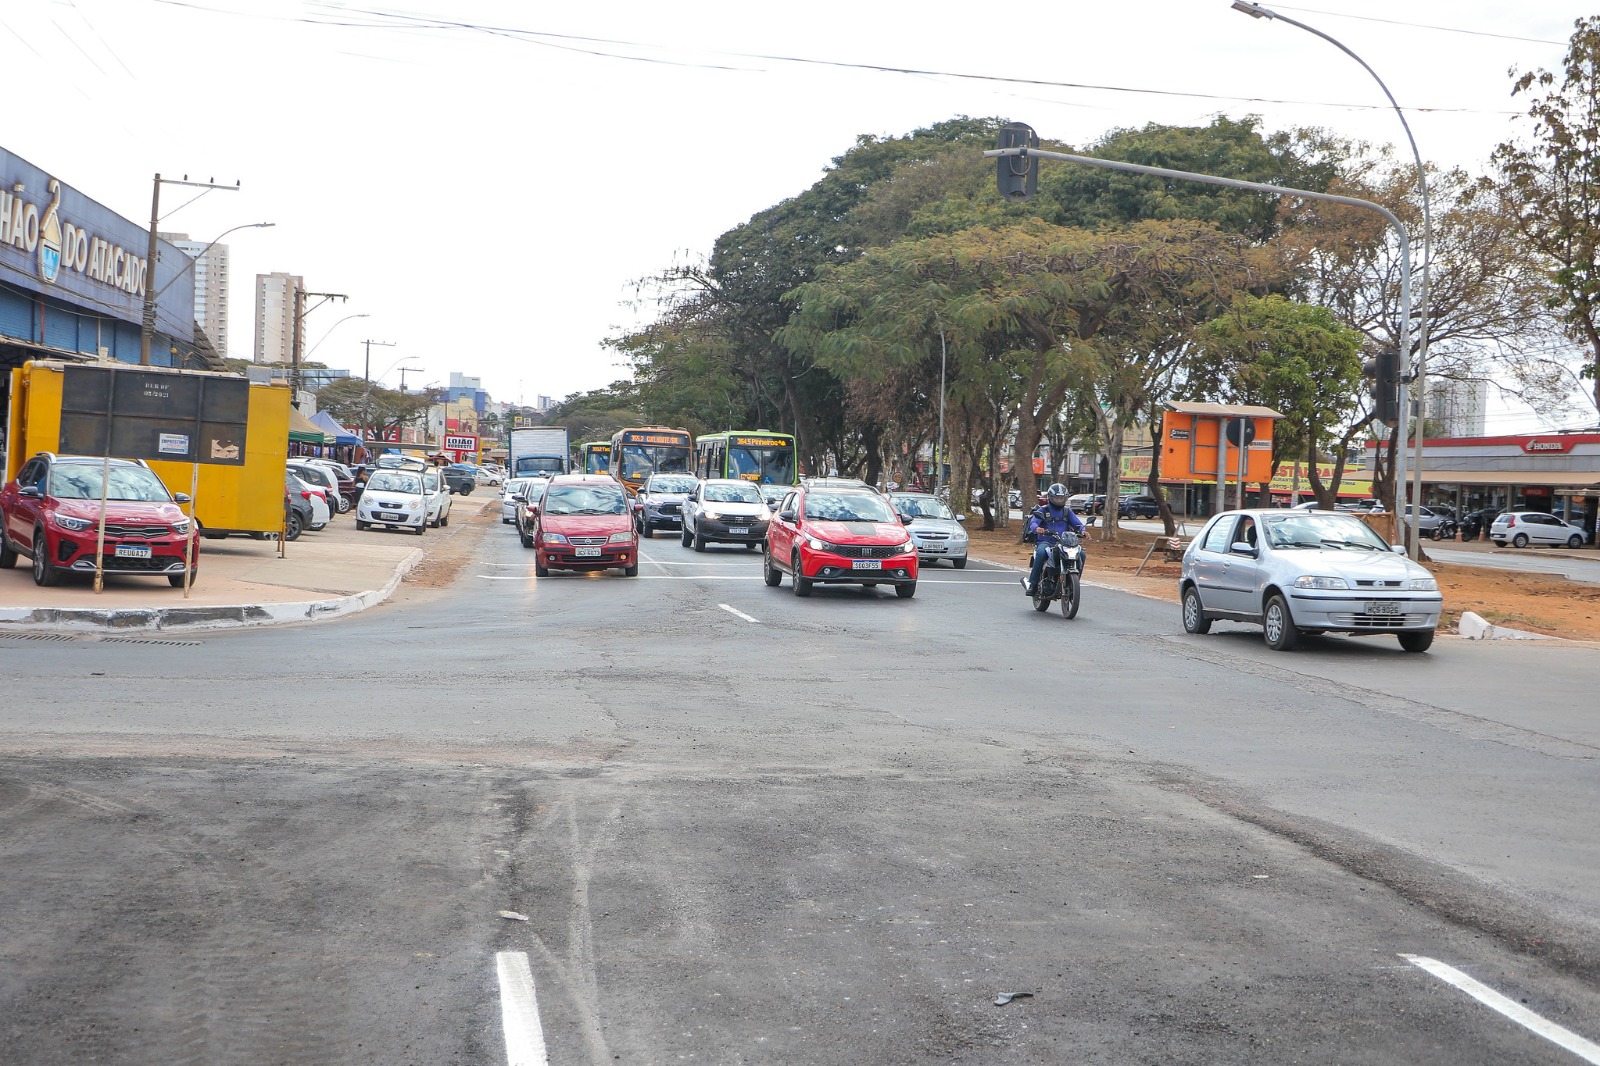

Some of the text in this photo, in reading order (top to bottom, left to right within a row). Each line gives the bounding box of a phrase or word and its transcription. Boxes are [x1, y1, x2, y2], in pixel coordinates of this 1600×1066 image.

[61, 222, 88, 272] DO
[86, 236, 147, 297] ATACADO
[447, 437, 473, 445] LOJÃO
[1533, 442, 1563, 450] HONDA
[861, 547, 873, 557] FIAT
